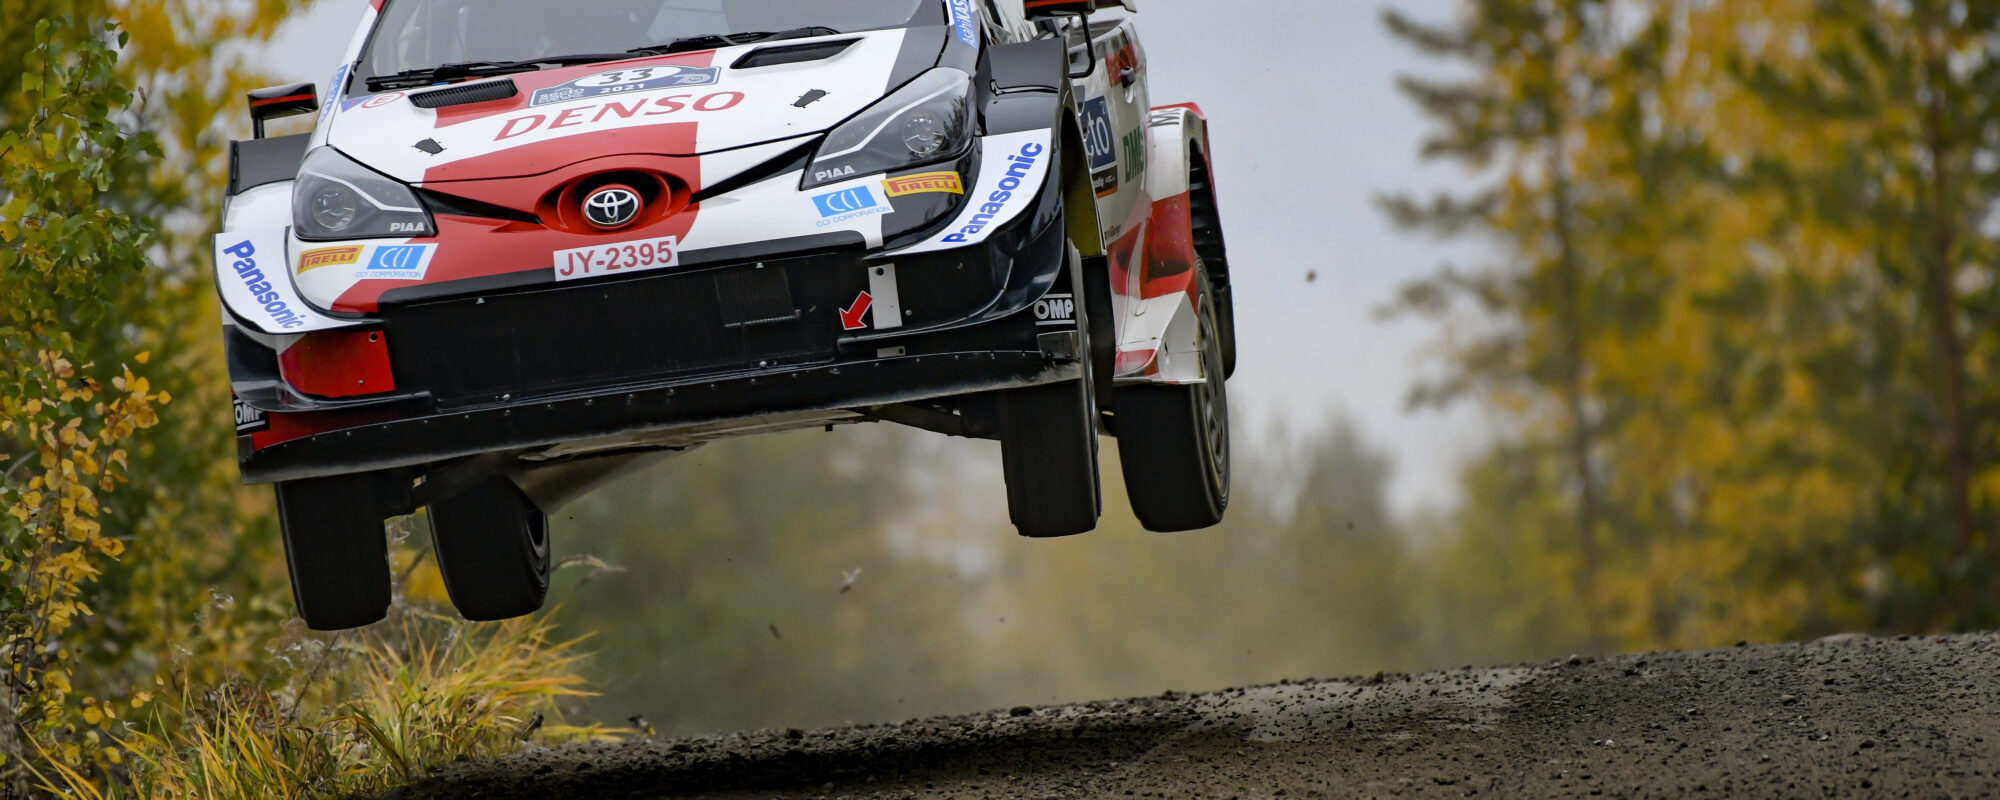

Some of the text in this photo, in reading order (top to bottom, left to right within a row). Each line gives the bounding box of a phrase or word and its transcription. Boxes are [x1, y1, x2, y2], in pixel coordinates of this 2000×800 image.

[599, 68, 654, 85] 33
[600, 83, 645, 93] 2021
[493, 91, 745, 141] DENSO
[814, 165, 856, 182] PIAA
[888, 173, 957, 194] PIRELLI
[941, 142, 1042, 243] Panasonic
[389, 222, 425, 232] PIAA
[815, 205, 890, 228] CCI CORPORATION
[301, 247, 359, 269] PIRELLI
[559, 240, 673, 276] JY-2395
[223, 240, 305, 329] Panasonic
[369, 271, 422, 279] CORPORATION
[1034, 298, 1074, 320] OMP
